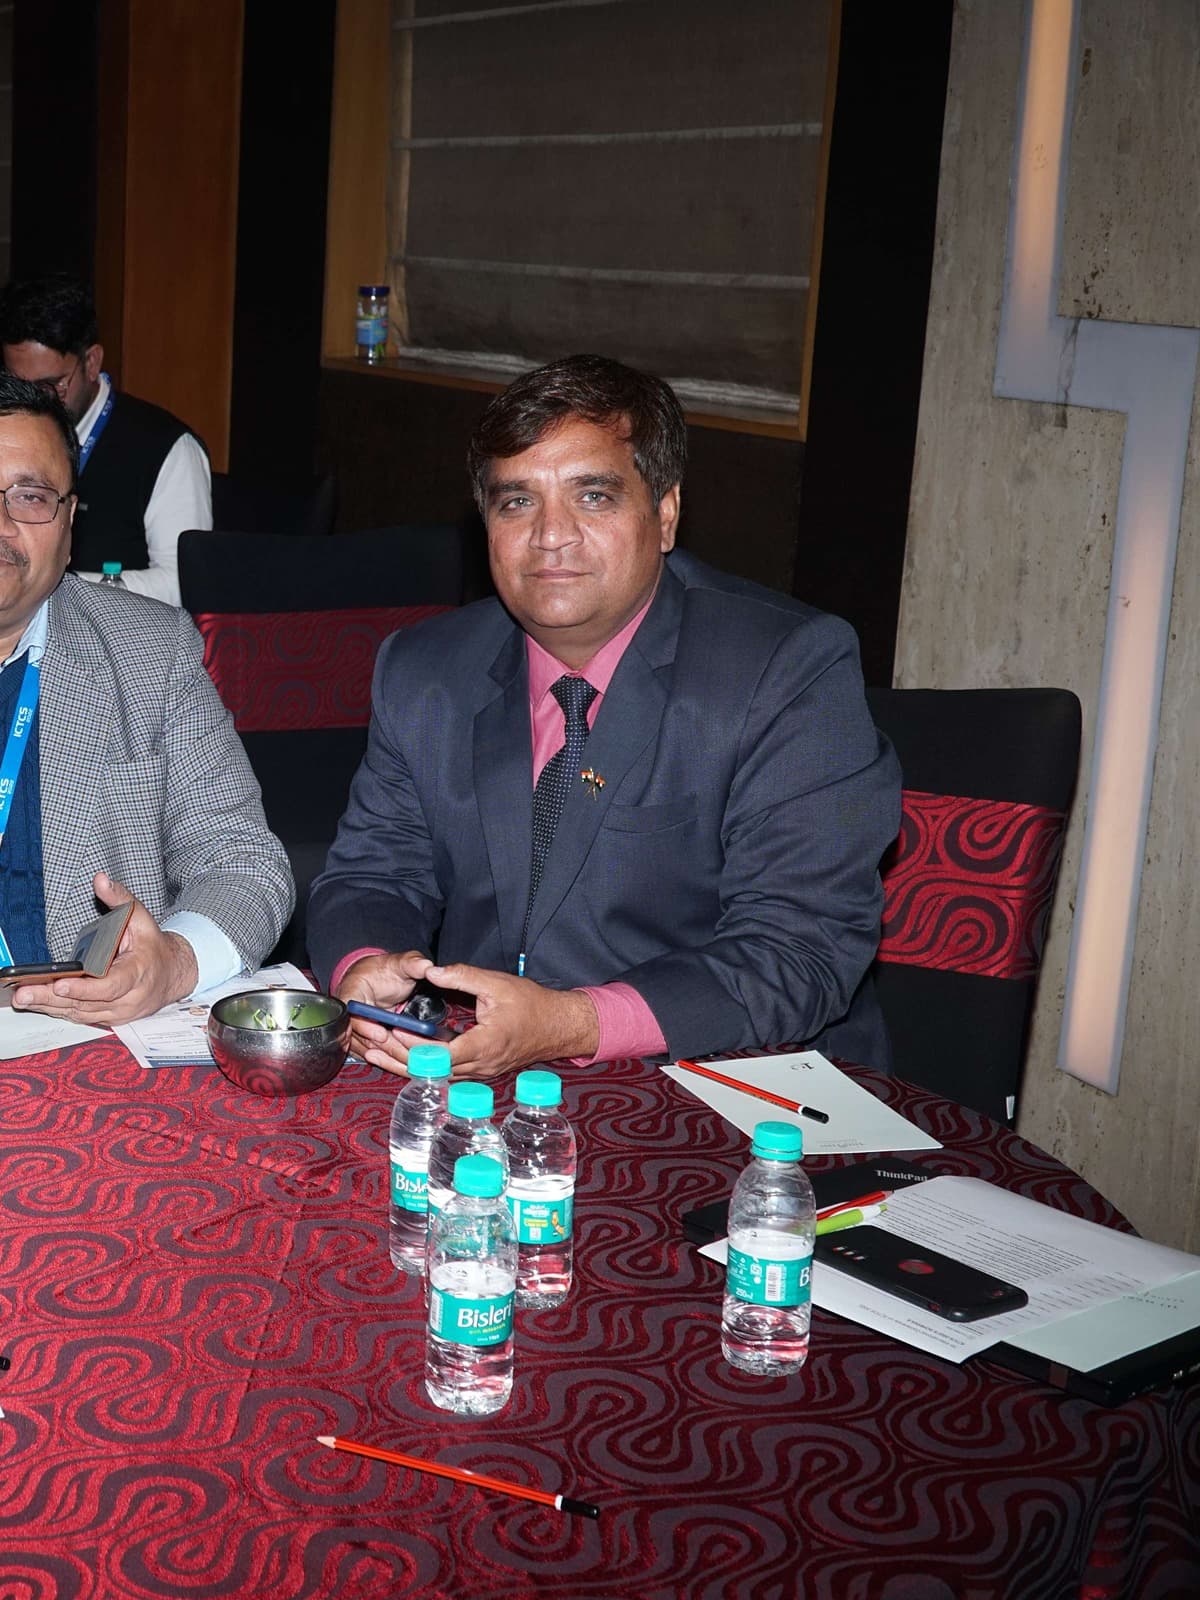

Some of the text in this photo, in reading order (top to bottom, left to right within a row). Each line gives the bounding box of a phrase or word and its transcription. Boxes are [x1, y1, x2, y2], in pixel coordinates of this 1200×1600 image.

[13, 706, 28, 738] ICTCS
[395, 1171, 429, 1193] Bisle
[875, 1169, 928, 1182] ThinkPad
[457, 1298, 512, 1328] Bisleri
